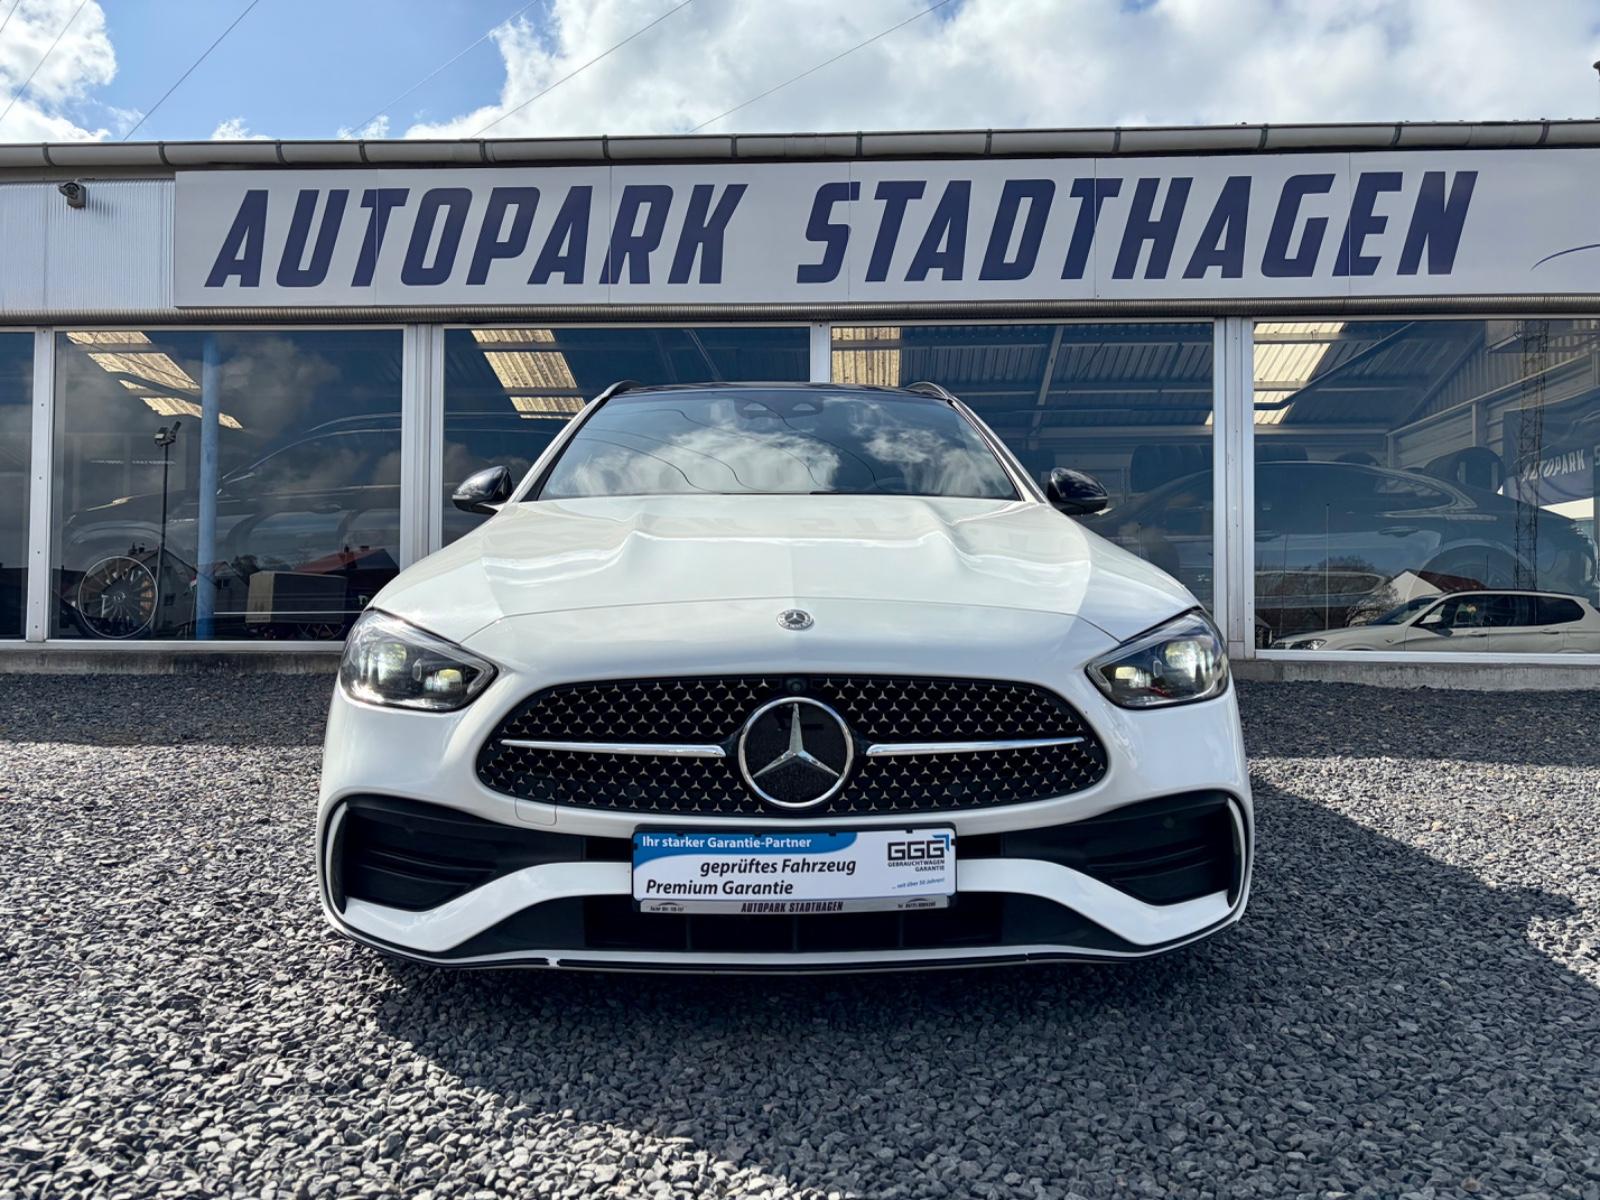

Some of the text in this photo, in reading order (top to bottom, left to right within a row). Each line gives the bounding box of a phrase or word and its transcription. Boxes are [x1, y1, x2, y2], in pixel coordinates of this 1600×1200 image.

[205, 171, 1478, 288] AUTOPARK STADTHAGEN
[642, 836, 812, 848] Ihr starker Garantie-Partner
[888, 840, 944, 860] GGG
[700, 858, 856, 877] geprüftes Fahrzeug
[646, 880, 793, 895] Premium Garantie
[741, 902, 843, 913] AUTOPARK STADTHAGEN
